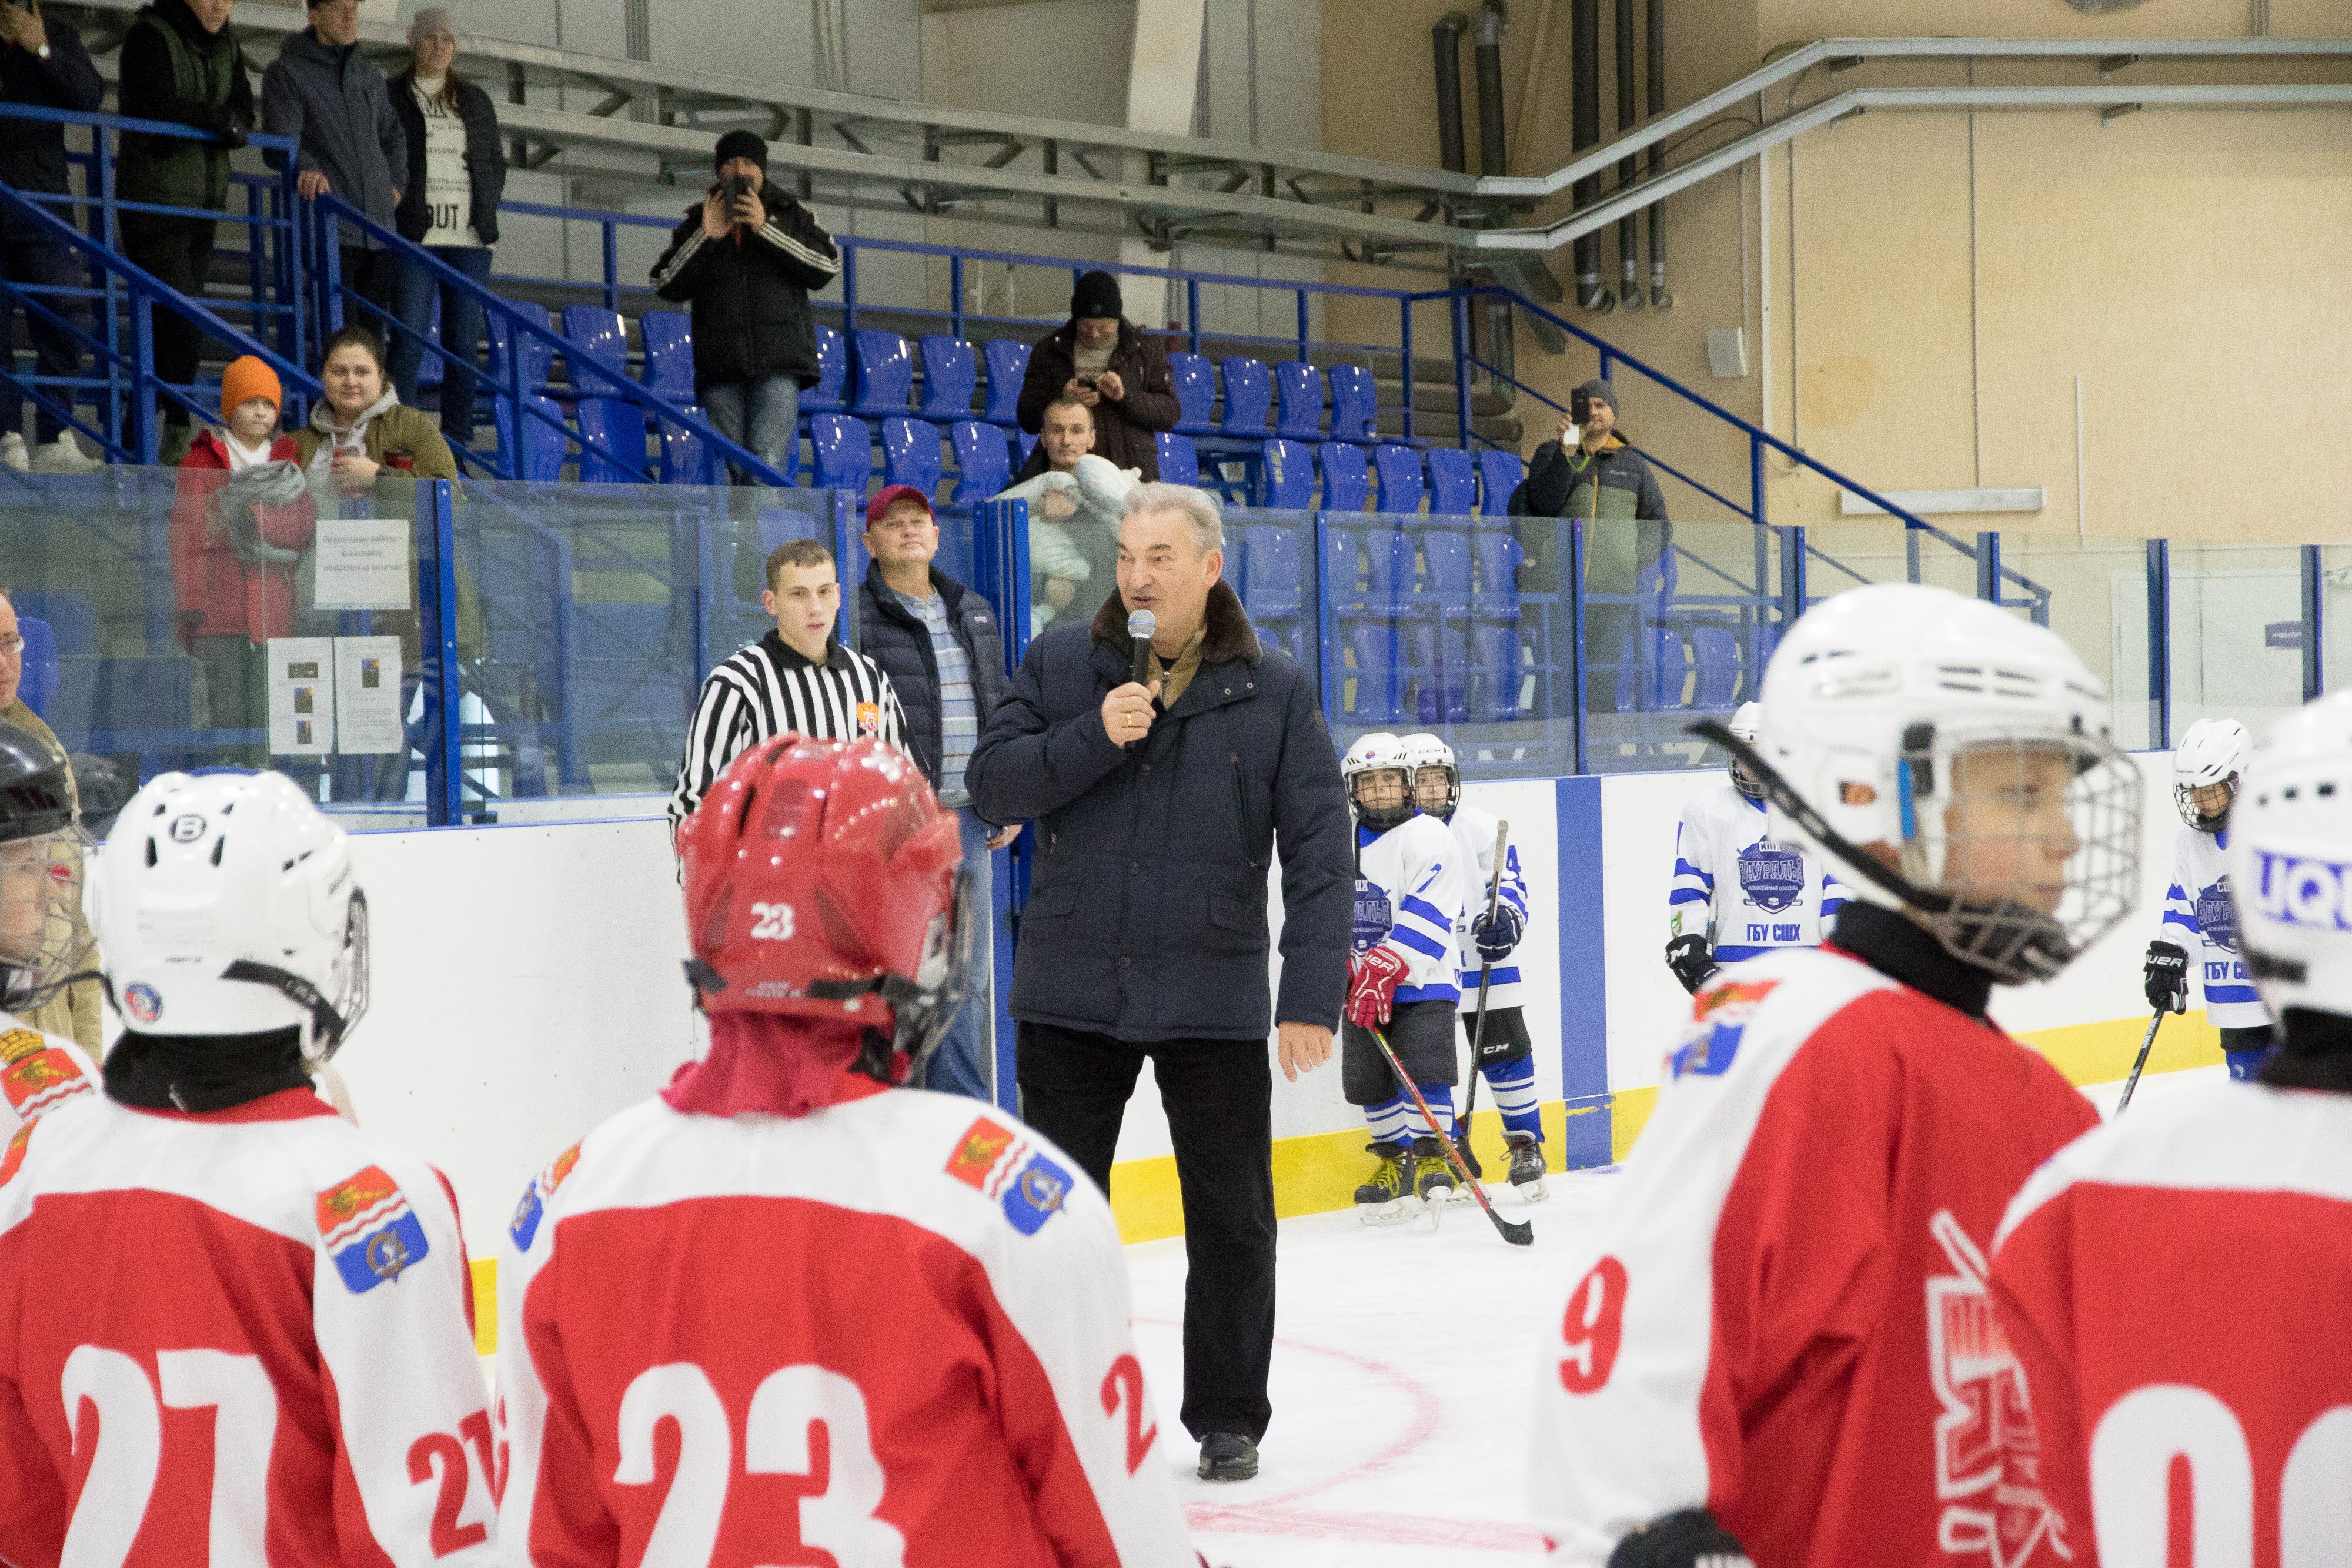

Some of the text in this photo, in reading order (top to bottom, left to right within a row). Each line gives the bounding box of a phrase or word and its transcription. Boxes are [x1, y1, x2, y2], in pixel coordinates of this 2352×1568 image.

[750, 902, 794, 940] 23
[1747, 924, 1801, 941] ГБУ СШХ
[2205, 962, 2229, 980] ГБУ
[1481, 1043, 1509, 1055] CM
[1559, 1255, 1629, 1396] 9
[61, 1344, 278, 1568] 27
[613, 1361, 908, 1568] 23
